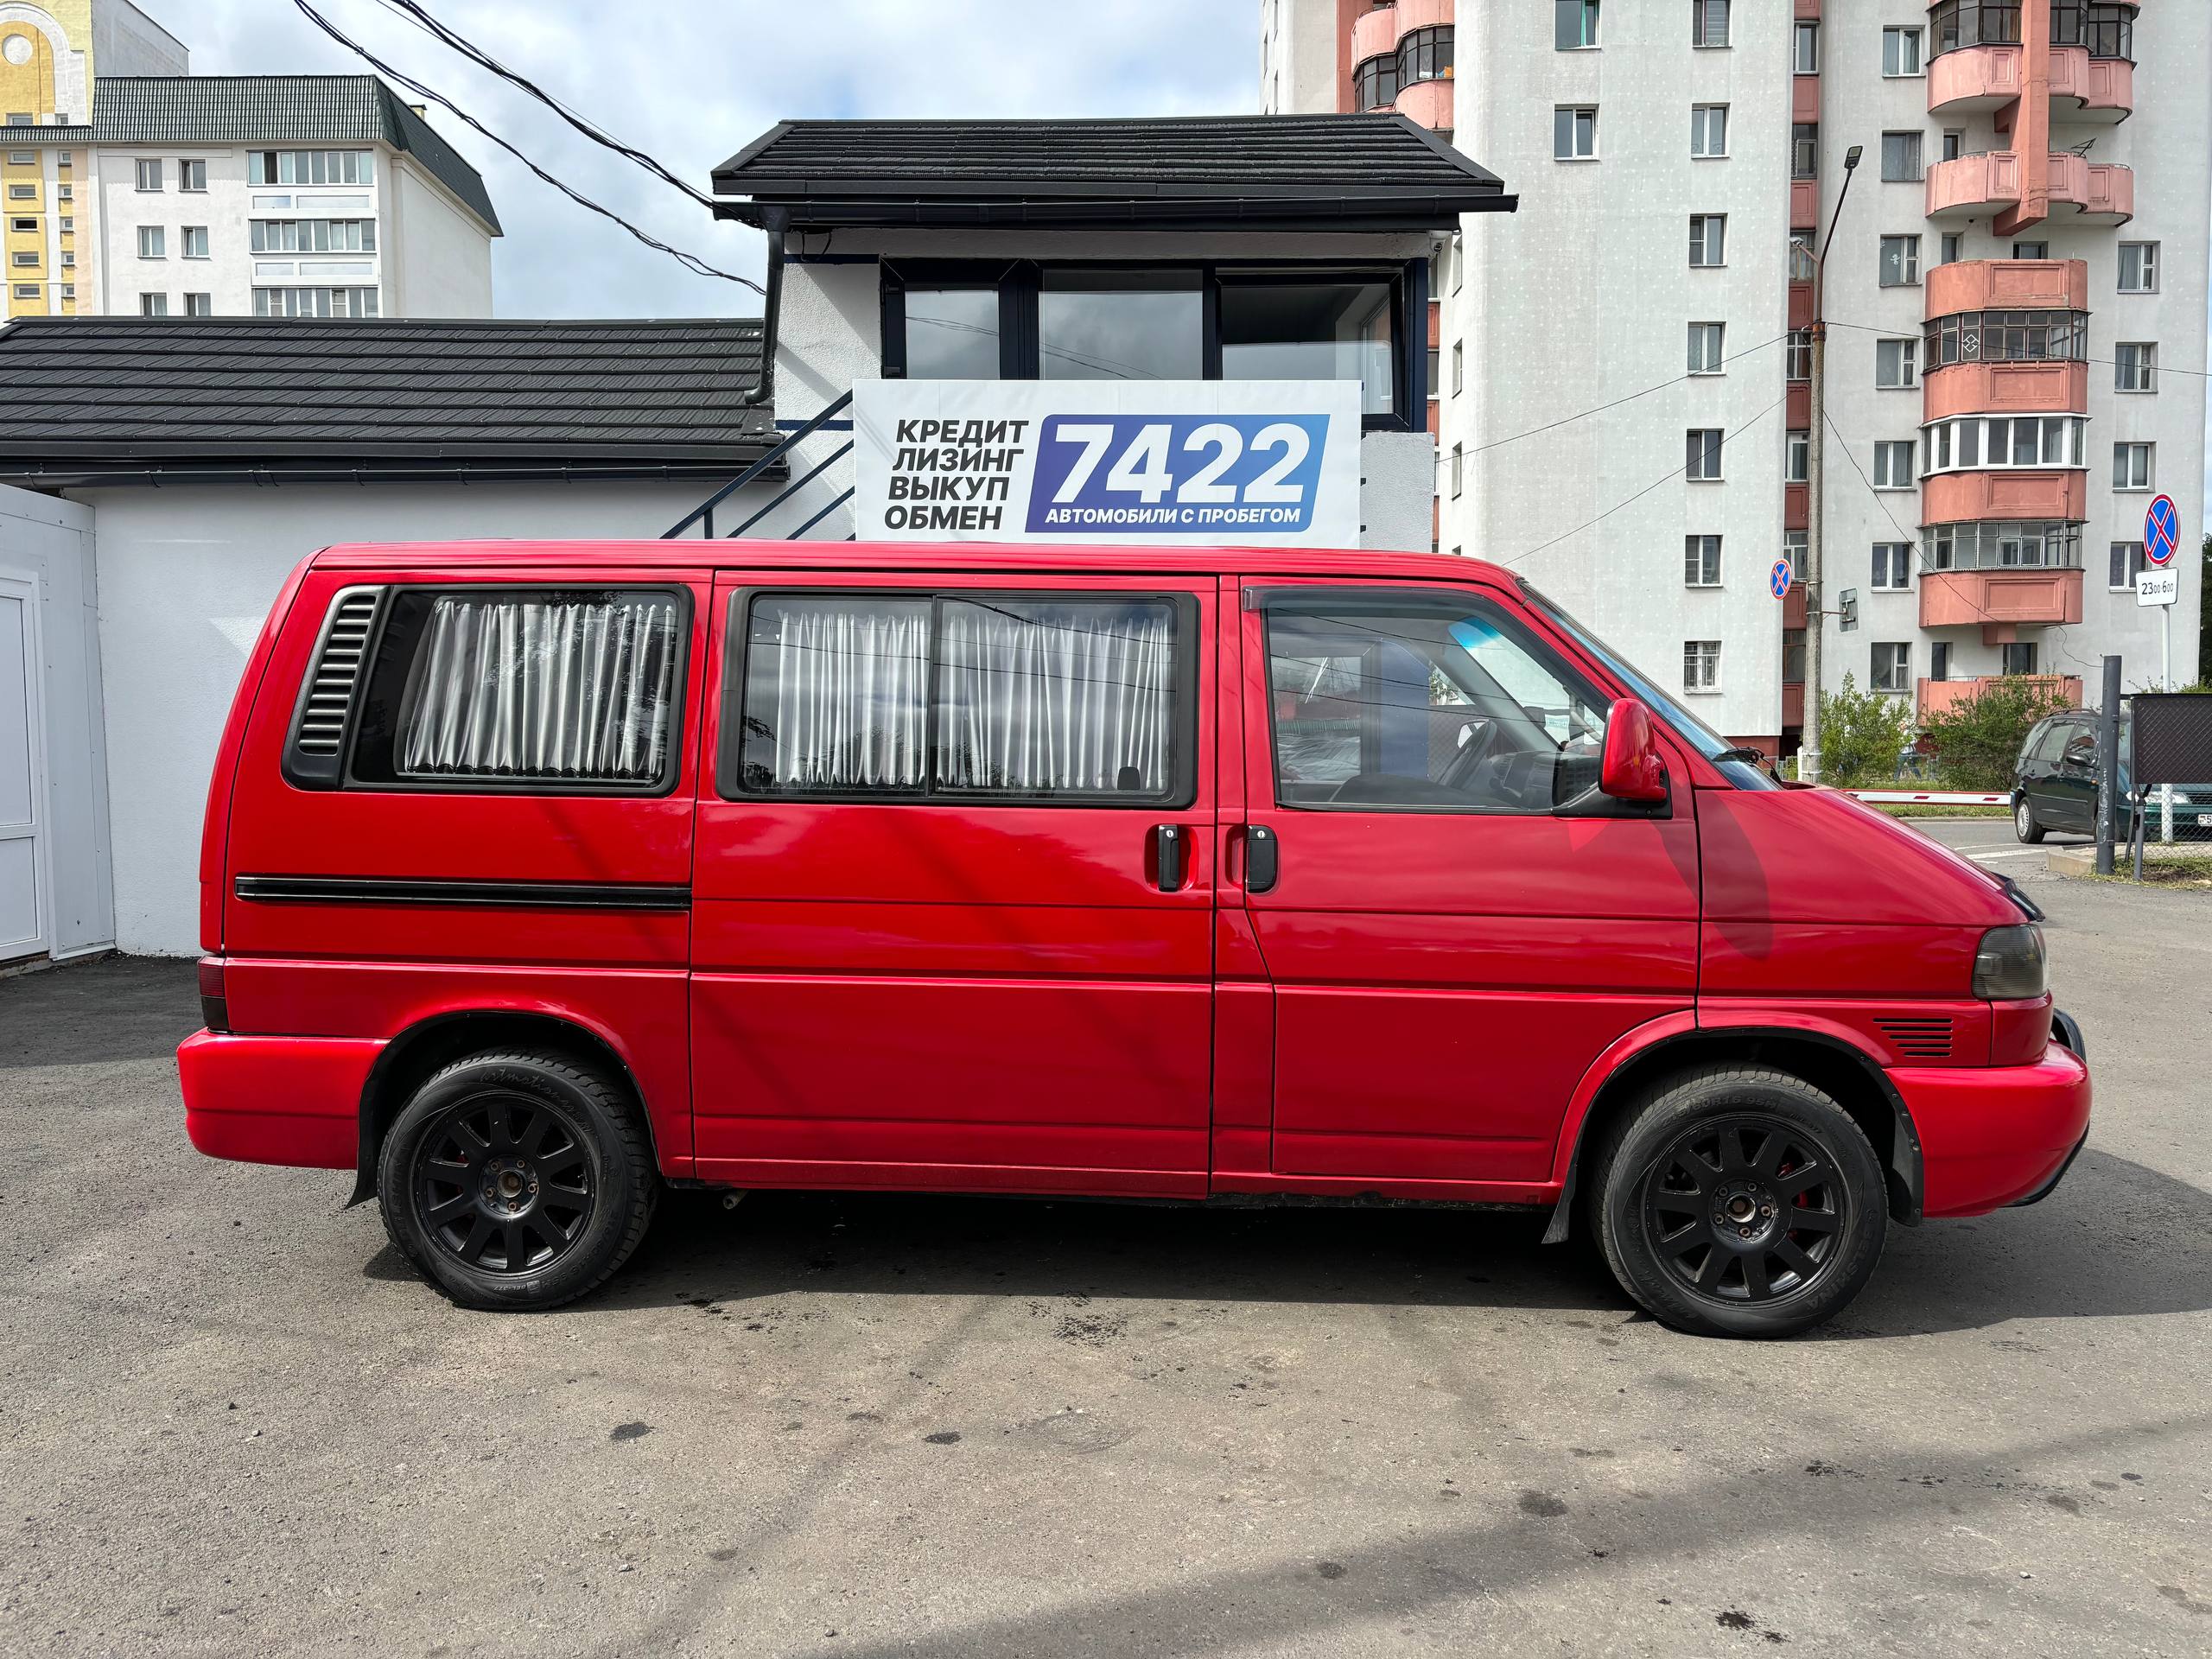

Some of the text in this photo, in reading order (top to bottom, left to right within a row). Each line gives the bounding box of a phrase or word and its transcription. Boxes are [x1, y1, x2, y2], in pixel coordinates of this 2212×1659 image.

[895, 419, 1030, 448] КРЕДИТ
[892, 448, 1025, 472] ЛИЗИНГ
[1052, 423, 1310, 503] 7422
[887, 476, 1010, 501] ВЫКУП
[884, 505, 1003, 531] ОБМЕН
[1045, 508, 1301, 524] АВТОМОБИЛИ С ПРОБЕГОМ
